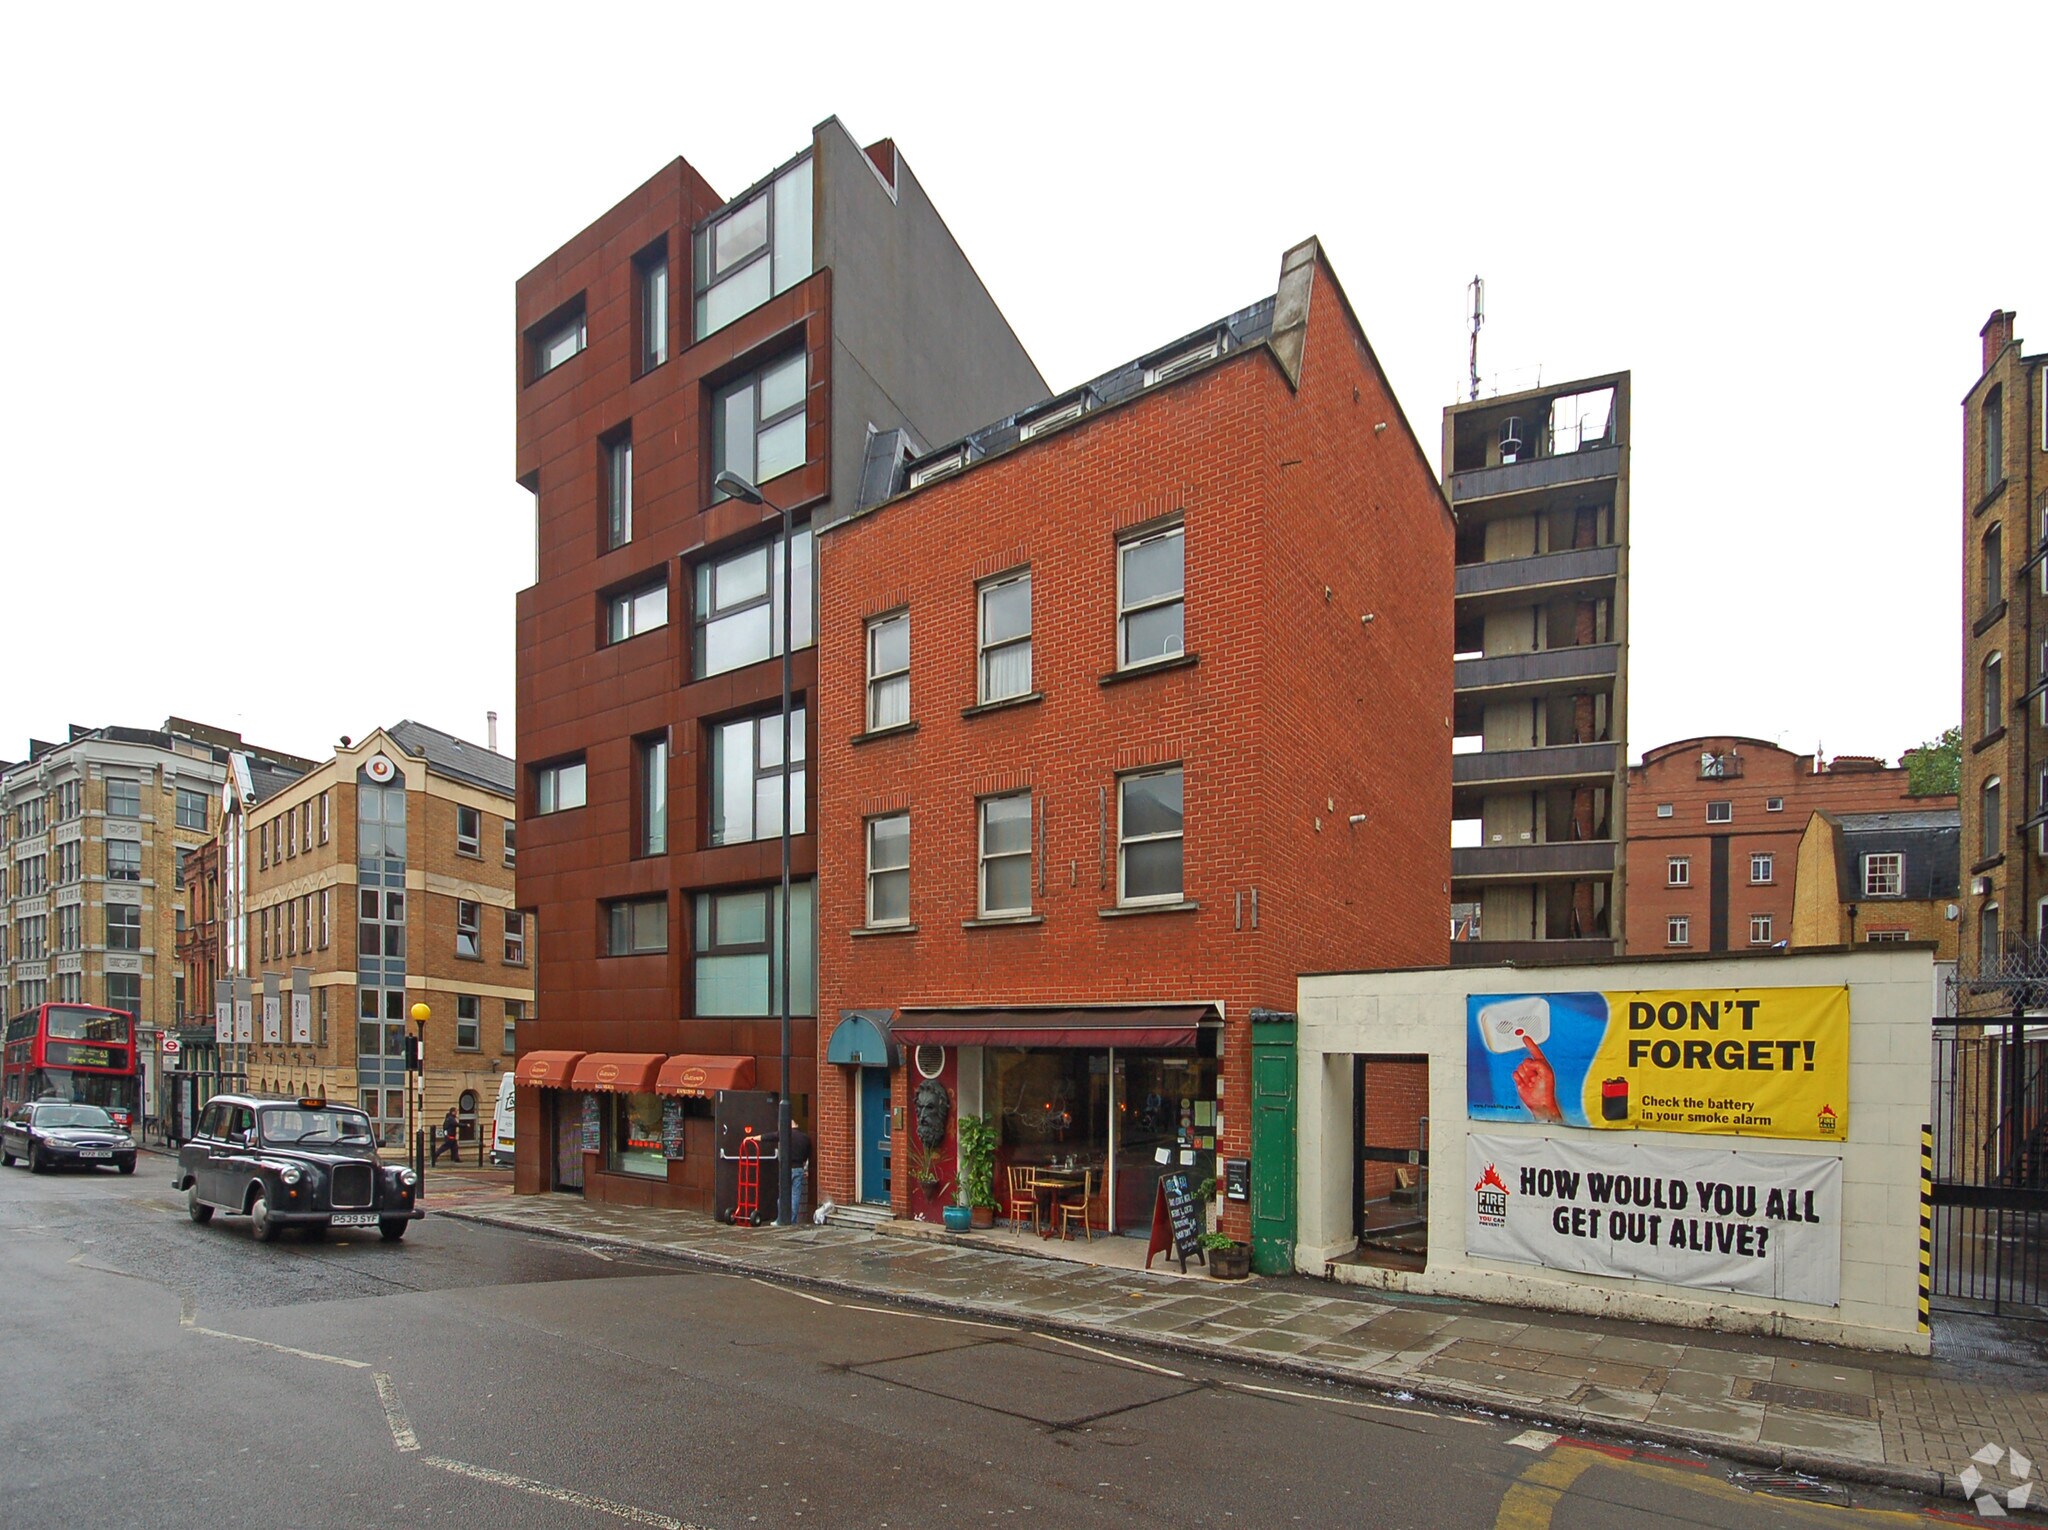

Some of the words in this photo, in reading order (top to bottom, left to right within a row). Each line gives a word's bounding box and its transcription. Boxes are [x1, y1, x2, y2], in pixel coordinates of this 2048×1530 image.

[1628, 1000, 1760, 1030] DON'T
[1628, 1040, 1816, 1071] FORGET!
[1642, 1095, 1679, 1108] Check
[1683, 1097, 1704, 1108] the
[1708, 1098, 1755, 1112] battery
[1642, 1109, 1653, 1120] in
[1656, 1112, 1684, 1122] your
[1688, 1111, 1729, 1123] smoke
[1733, 1113, 1772, 1126] alarm
[1480, 1193, 1505, 1206] FIRE
[1520, 1167, 1580, 1200] HOW
[1587, 1172, 1688, 1210] WOULD
[1696, 1181, 1757, 1217] YOU
[1765, 1188, 1820, 1223] ALL
[1479, 1204, 1505, 1215] KILLS
[333, 1215, 358, 1223] P539
[1553, 1206, 1601, 1239] GET
[1609, 1211, 1662, 1246] OUT
[1669, 1217, 1769, 1258] ALIVE?
